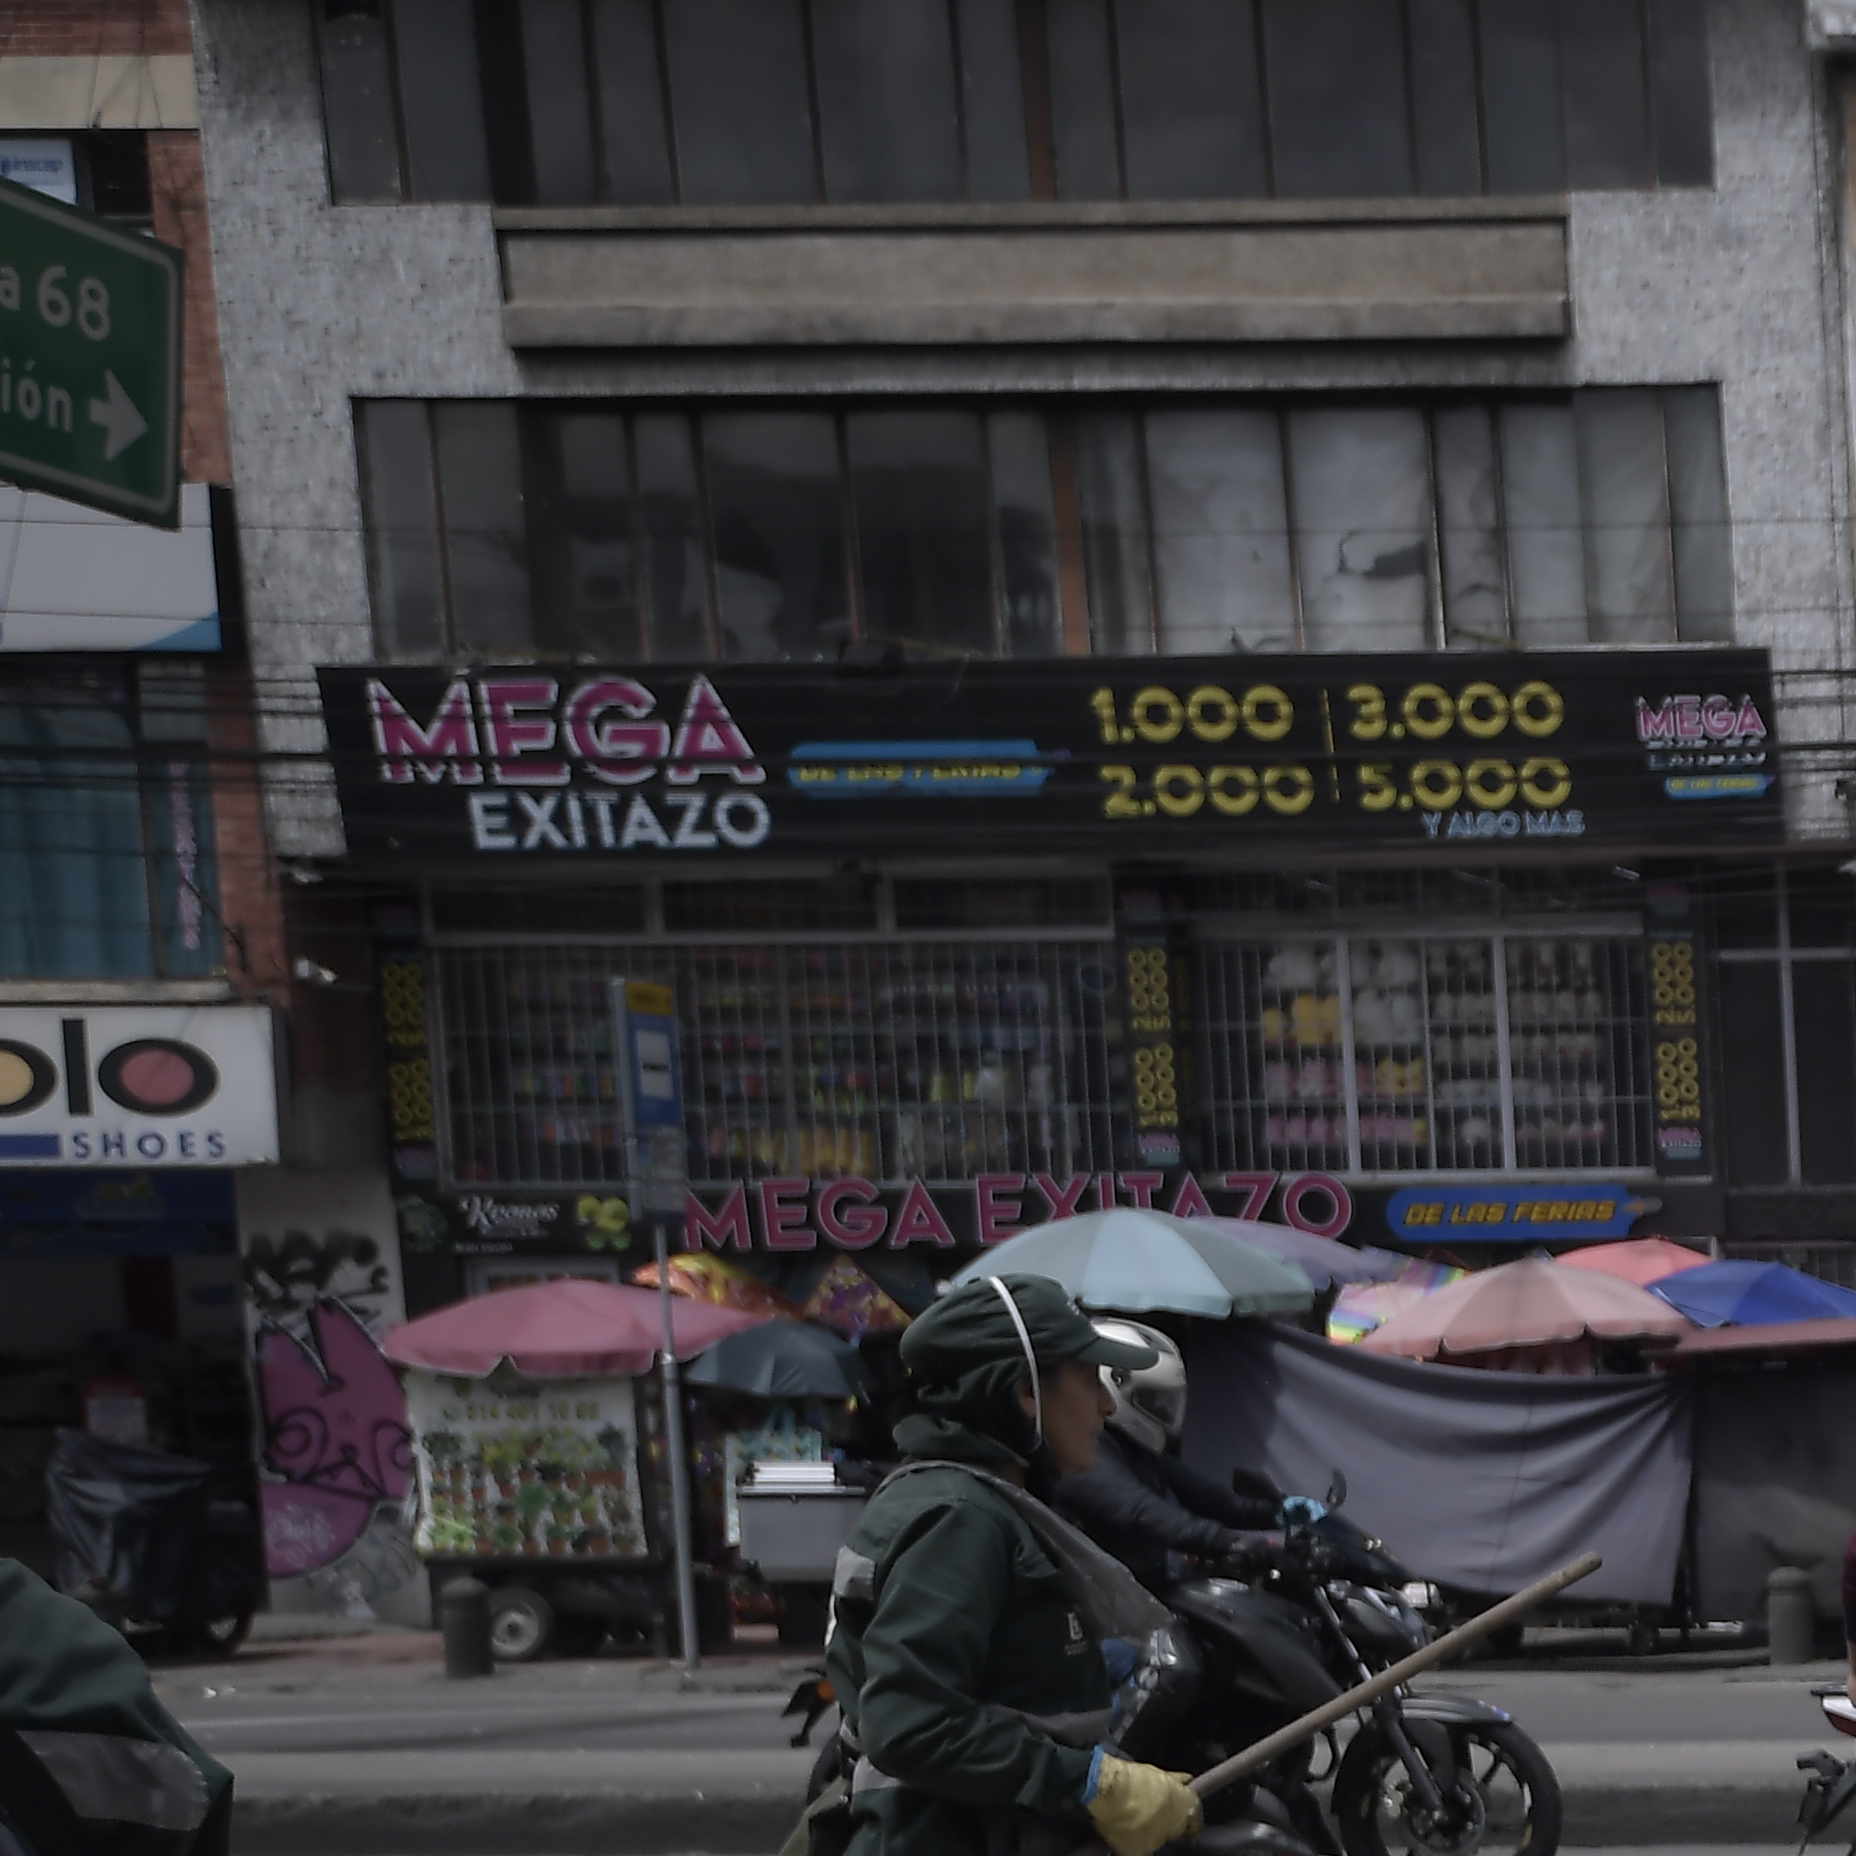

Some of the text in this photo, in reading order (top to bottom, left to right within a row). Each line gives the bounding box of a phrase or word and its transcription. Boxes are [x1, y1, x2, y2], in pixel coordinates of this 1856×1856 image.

[37, 265, 112, 342] 68
[366, 672, 768, 787] MEGA
[1090, 680, 1565, 744] 1.000 3.000
[1636, 693, 1768, 741] MEGA
[1099, 757, 1573, 820] 2.000 5.000
[467, 792, 773, 852] EXITAZO
[1446, 811, 1523, 837] ALGO
[72, 1131, 228, 1159] SHOES
[684, 1174, 957, 1252] MEGA
[1402, 1198, 1616, 1227] DE LAS FERIAS
